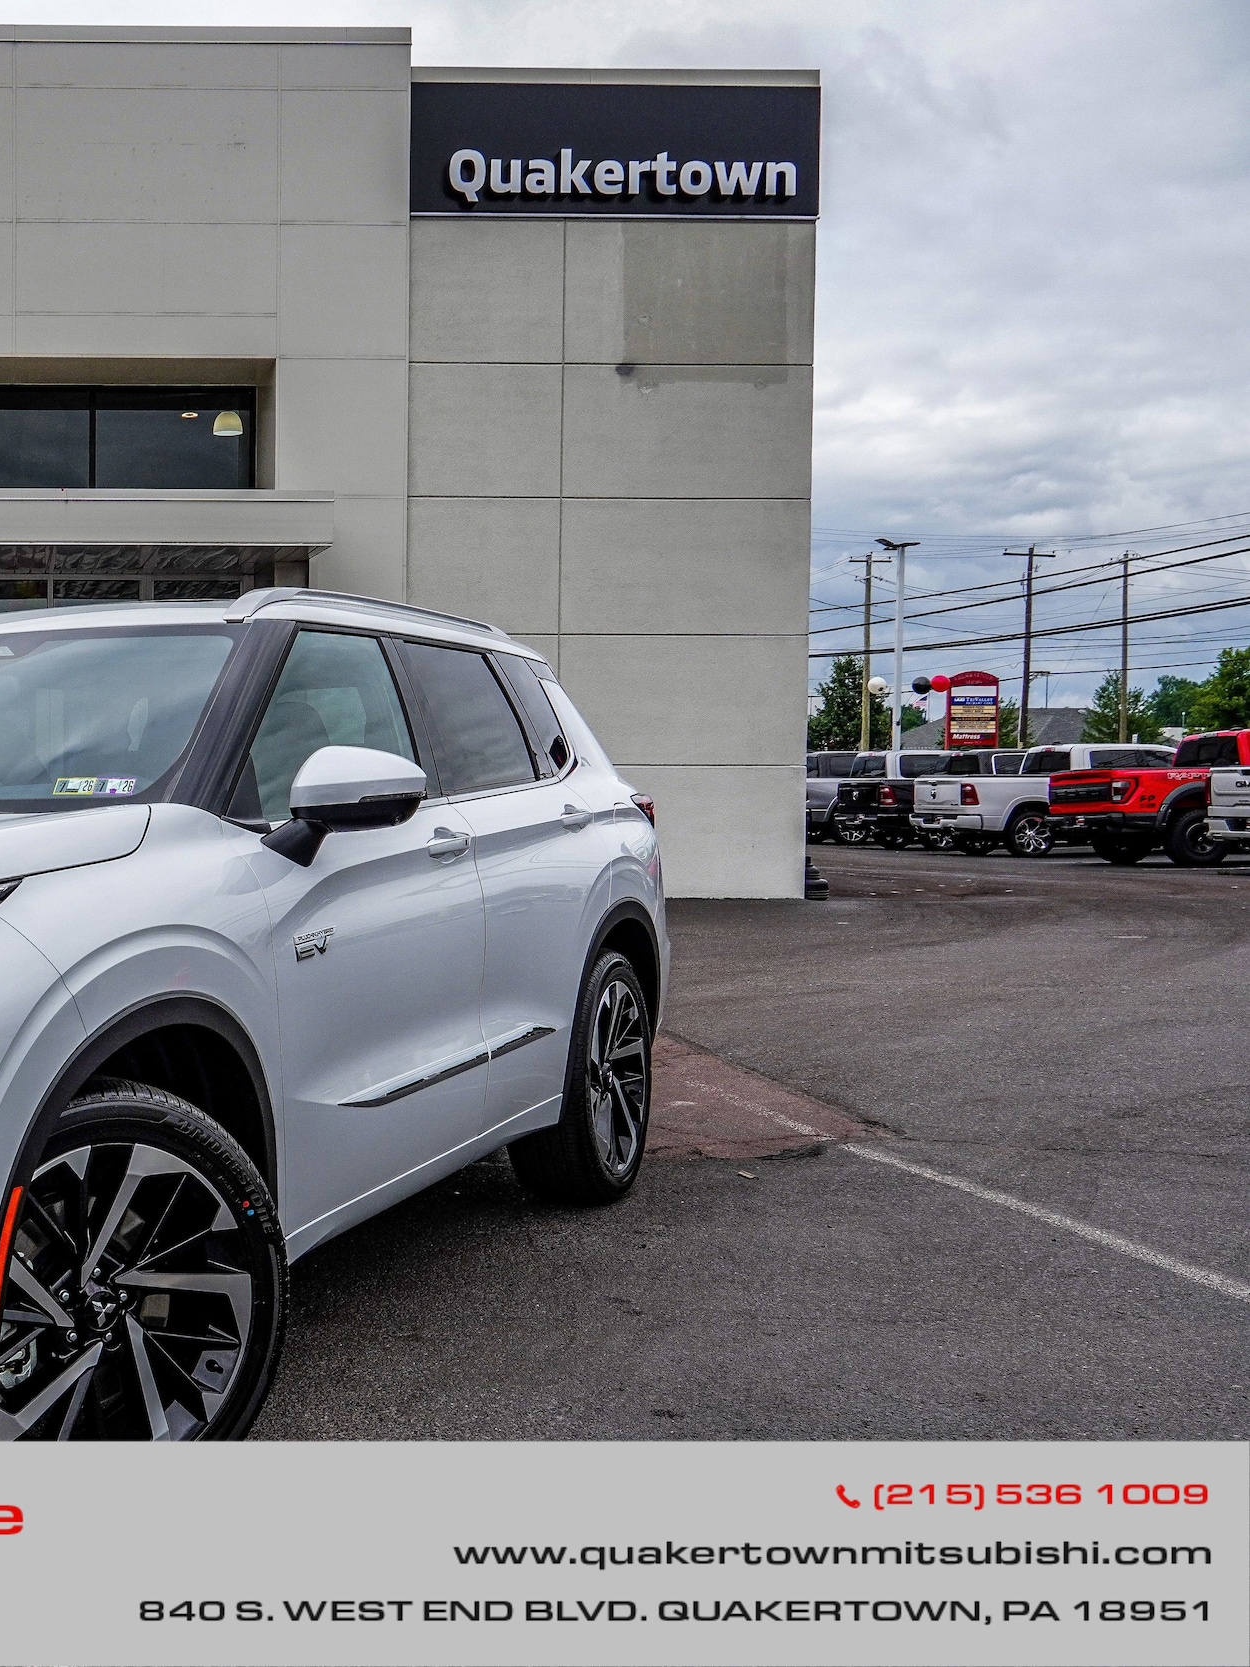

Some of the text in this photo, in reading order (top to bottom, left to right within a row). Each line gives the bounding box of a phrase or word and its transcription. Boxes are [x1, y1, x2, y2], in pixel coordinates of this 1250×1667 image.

[448, 147, 798, 202] Quakertown
[82, 780, 94, 792] 26
[122, 780, 134, 792] 26
[295, 936, 330, 962] EV
[174, 1117, 275, 1234] BRIDGESTONE
